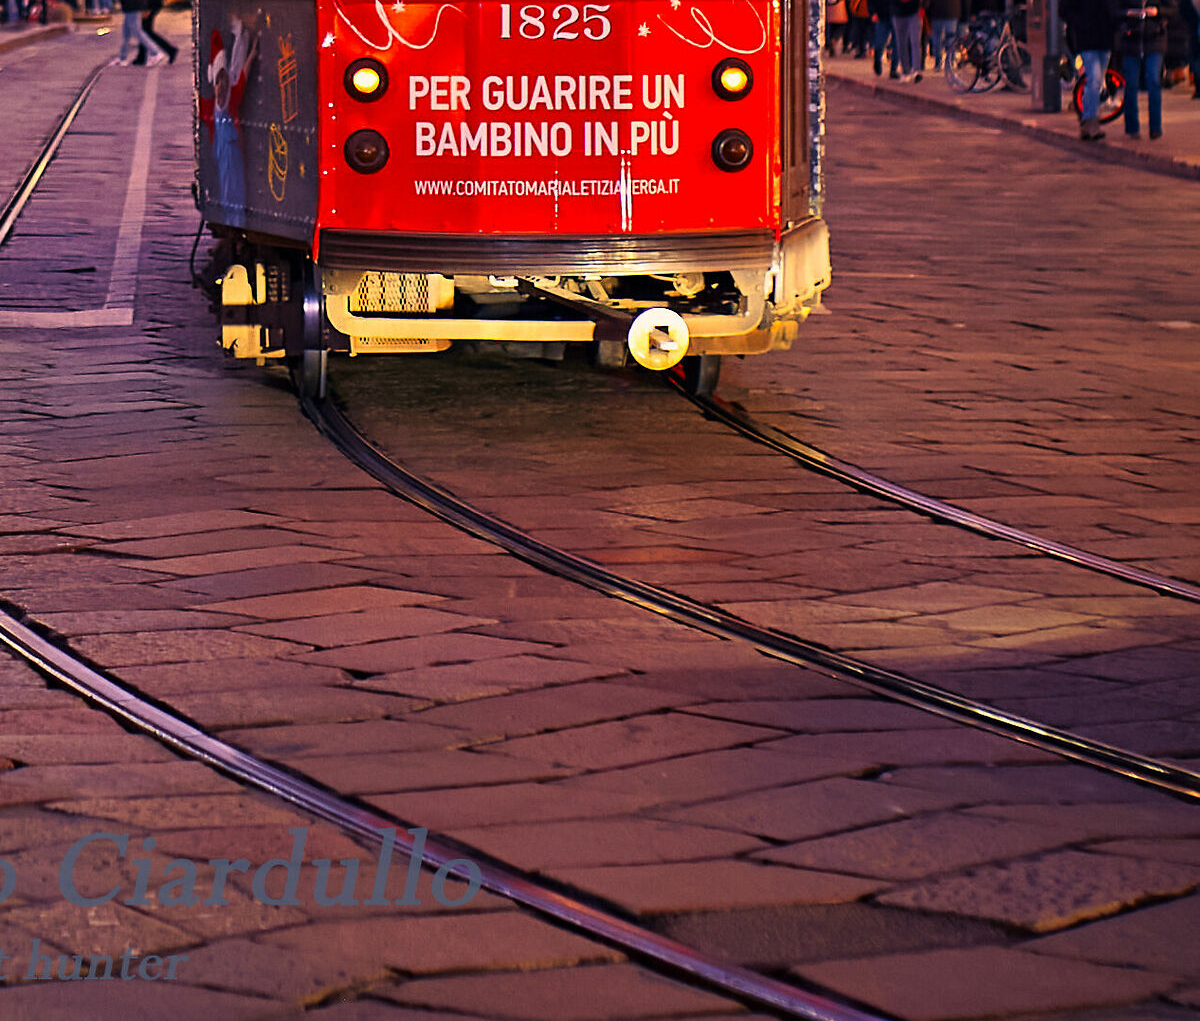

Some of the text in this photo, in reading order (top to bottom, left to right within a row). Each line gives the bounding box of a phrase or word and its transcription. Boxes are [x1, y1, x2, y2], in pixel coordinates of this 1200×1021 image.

[500, 4, 611, 40] 1825
[409, 74, 685, 110] PER GUARIRE UN
[415, 111, 679, 156] BAMBINO IN PIÙ
